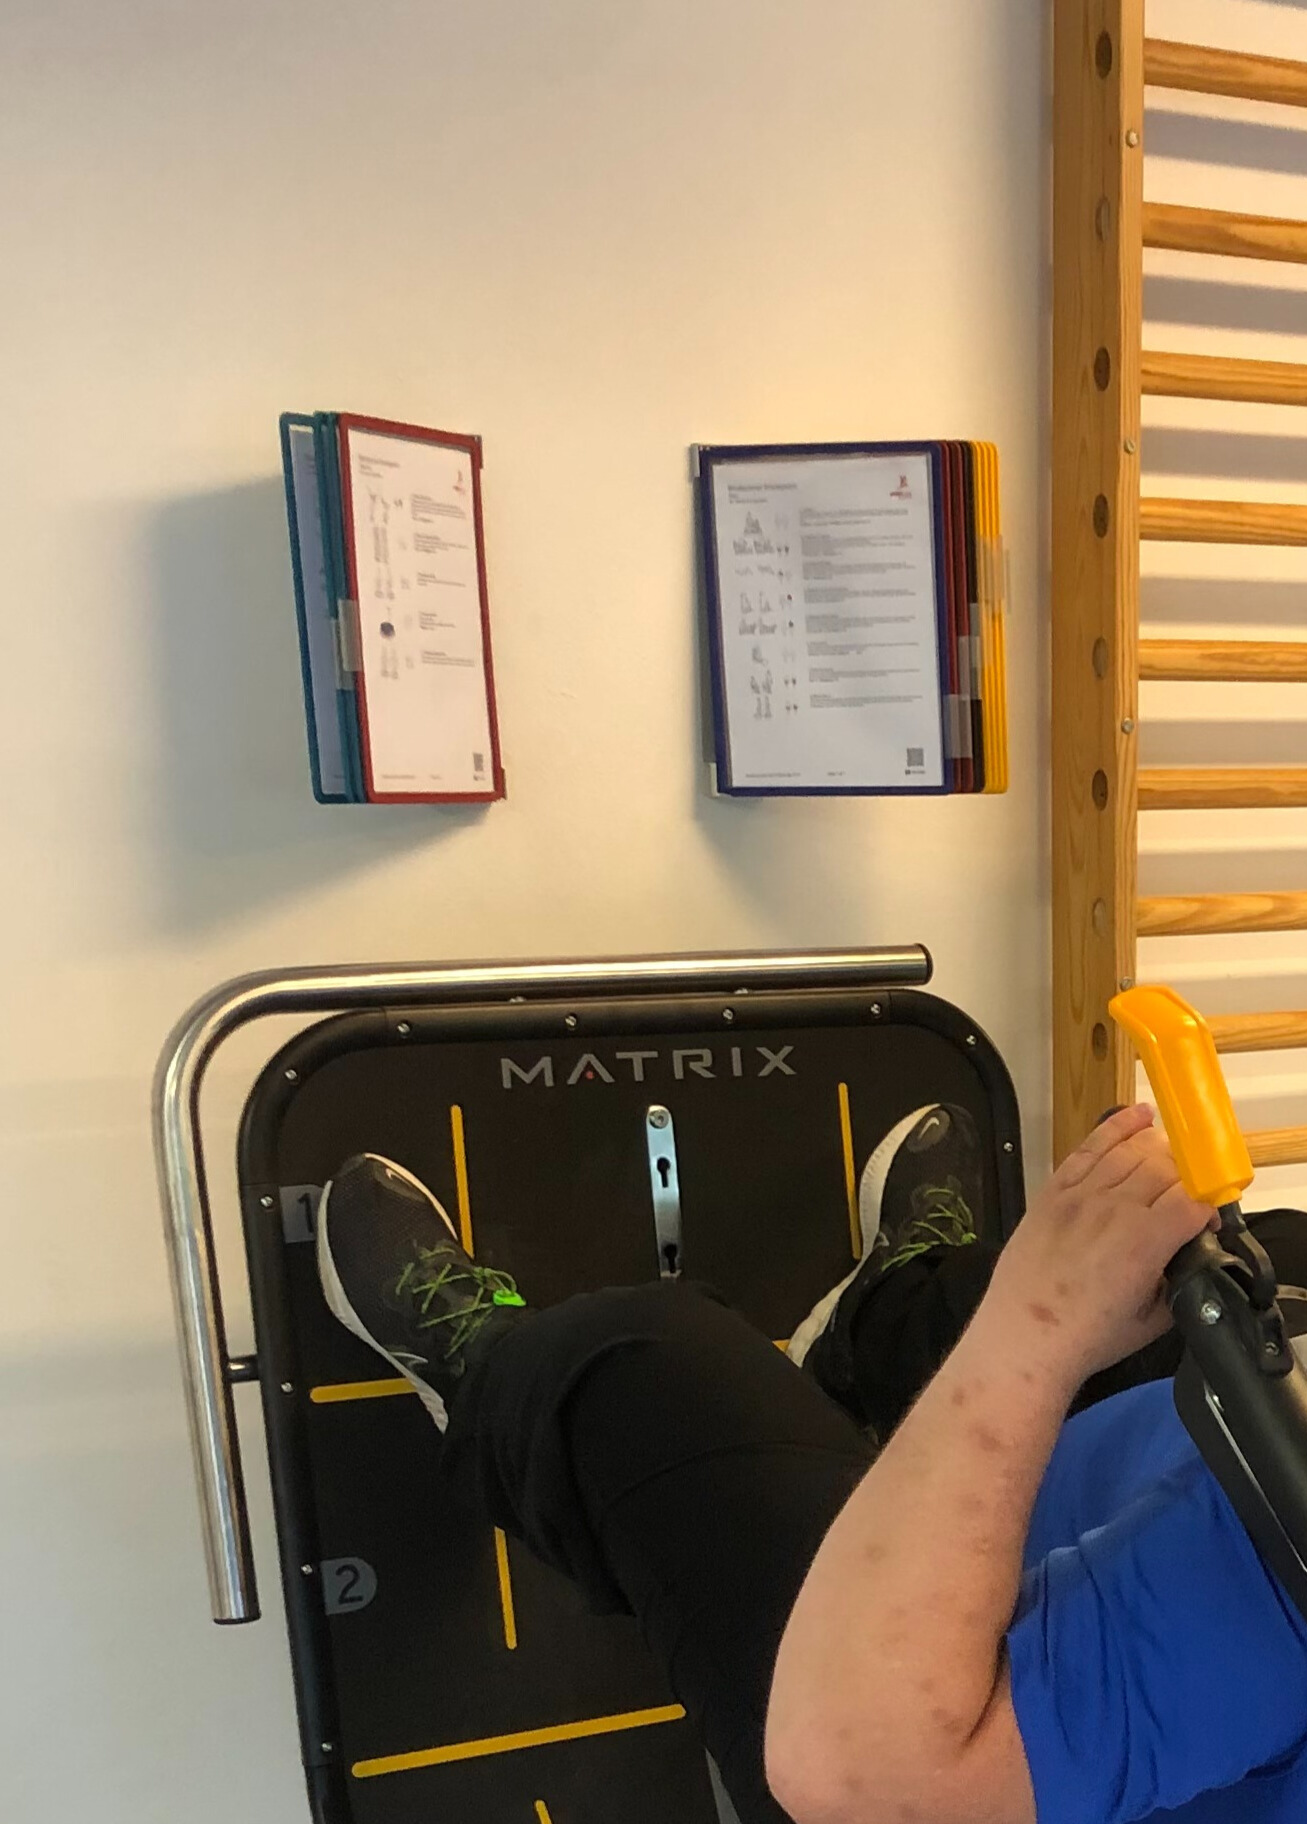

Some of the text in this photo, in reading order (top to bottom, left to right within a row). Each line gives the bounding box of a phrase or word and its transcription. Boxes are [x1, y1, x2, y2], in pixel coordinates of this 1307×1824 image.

[501, 1045, 798, 1089] MATRIX
[298, 1192, 315, 1233] 1
[335, 1563, 363, 1603] 2
